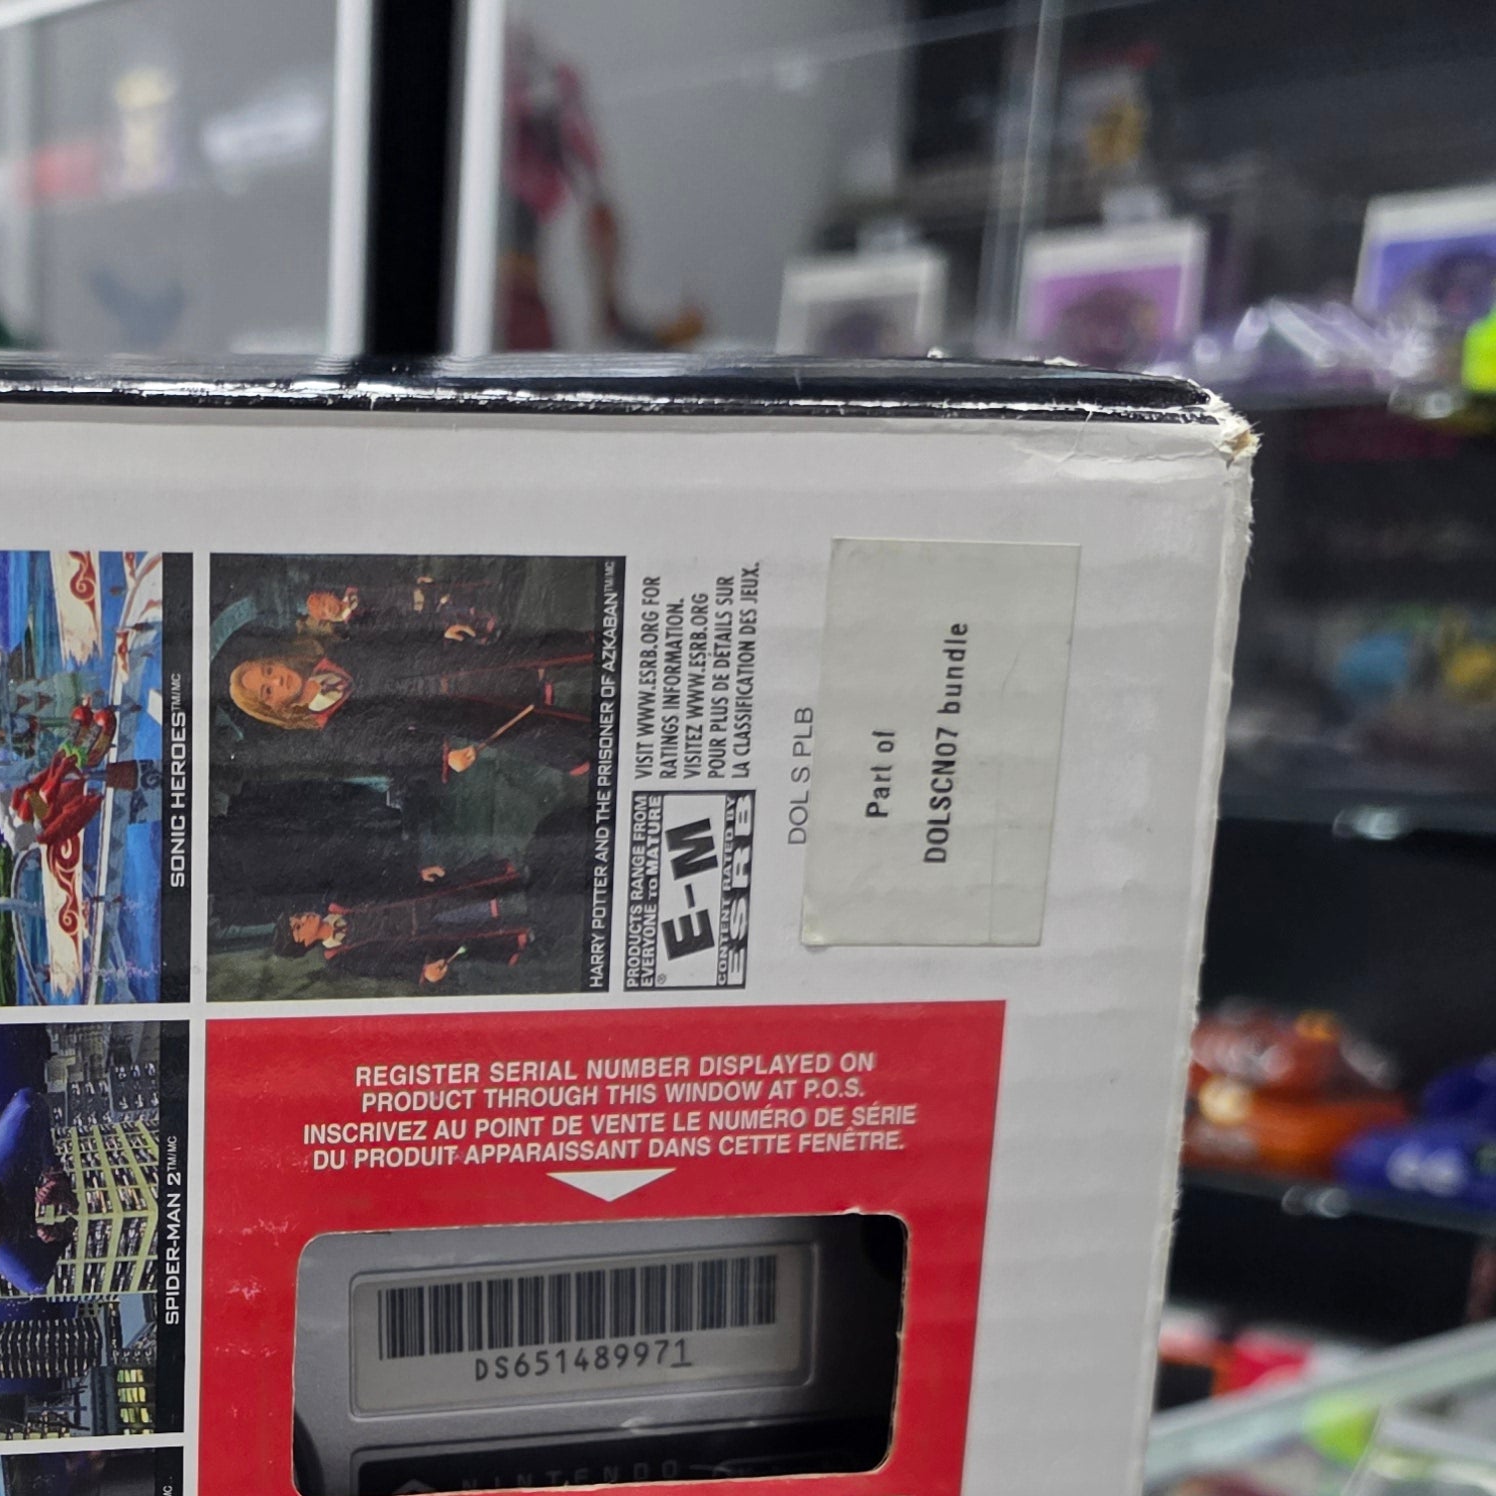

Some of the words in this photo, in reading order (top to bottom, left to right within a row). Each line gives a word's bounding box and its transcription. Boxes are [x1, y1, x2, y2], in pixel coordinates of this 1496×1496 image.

[641, 576, 661, 606] FOR
[715, 576, 735, 606] SUR
[739, 561, 760, 604] JEUX.
[712, 610, 733, 669] DÉTAILS
[738, 608, 758, 636] DES
[636, 610, 660, 738] WWW.ESRB.ORG
[662, 597, 685, 710] INFORMATION.
[686, 592, 709, 720] WWW.ESRB.ORG
[937, 622, 969, 715] bundle
[600, 674, 616, 698] OF
[711, 673, 731, 692] DE
[732, 640, 756, 757] CLASSIFICATION
[709, 696, 730, 733] PLUS
[792, 706, 815, 758] PLB
[596, 701, 615, 787] PRISONER
[634, 741, 654, 780] VISIT
[659, 714, 680, 779] RATINGS
[683, 724, 704, 779] VISITEZ
[707, 737, 728, 779] POUR
[871, 730, 896, 754] of
[731, 760, 751, 779] LA
[790, 765, 812, 784] S
[865, 765, 893, 818] Part
[923, 726, 959, 864] DOLSCN07
[595, 790, 612, 824] THE
[632, 795, 648, 842] FROM
[722, 795, 736, 822] BY
[787, 790, 810, 845] DOL
[170, 814, 186, 888] SONIC
[594, 826, 610, 863] AND
[645, 795, 662, 876] MATURE
[720, 826, 734, 892] RATED
[591, 865, 609, 930] POTTER
[630, 845, 646, 901] RANGE
[727, 793, 753, 986] ESRB
[589, 932, 606, 988] HARRY
[625, 904, 643, 988] PRODUCTS
[641, 904, 657, 988] EVERYONE
[717, 897, 731, 986] CONTENT
[355, 1062, 480, 1087] REGISTER
[489, 1059, 578, 1083] SERIAL
[586, 1056, 691, 1080] NUMBER
[699, 1052, 833, 1077] DISPLAYED
[839, 1051, 875, 1073] ON
[361, 1088, 477, 1113] PRODUCT
[483, 1084, 599, 1109] THROUGH
[606, 1082, 658, 1105] THIS
[664, 1080, 763, 1104] WINDOW
[767, 1078, 797, 1100] AT
[803, 1076, 865, 1099] P.O.S.
[303, 1119, 428, 1145] INSCRIVEZ
[433, 1118, 467, 1141] AU
[474, 1115, 543, 1139] POINT
[551, 1114, 583, 1137] DE
[590, 1112, 665, 1135] VENTE
[672, 1110, 701, 1133] LE
[708, 1103, 808, 1131] NUMÉRO
[813, 1106, 845, 1128] DE
[851, 1100, 917, 1127] SÉRIE
[313, 1148, 346, 1171] DU
[353, 1144, 459, 1169] PRODUIT
[463, 1138, 641, 1165] APPARAISSANT
[648, 1136, 712, 1159] DANS
[718, 1133, 791, 1156] CETTE
[798, 1125, 905, 1153] FENÊTRE.
[165, 1192, 181, 1325] SPIDER-MAN
[474, 1337, 693, 1382] DS651489971
